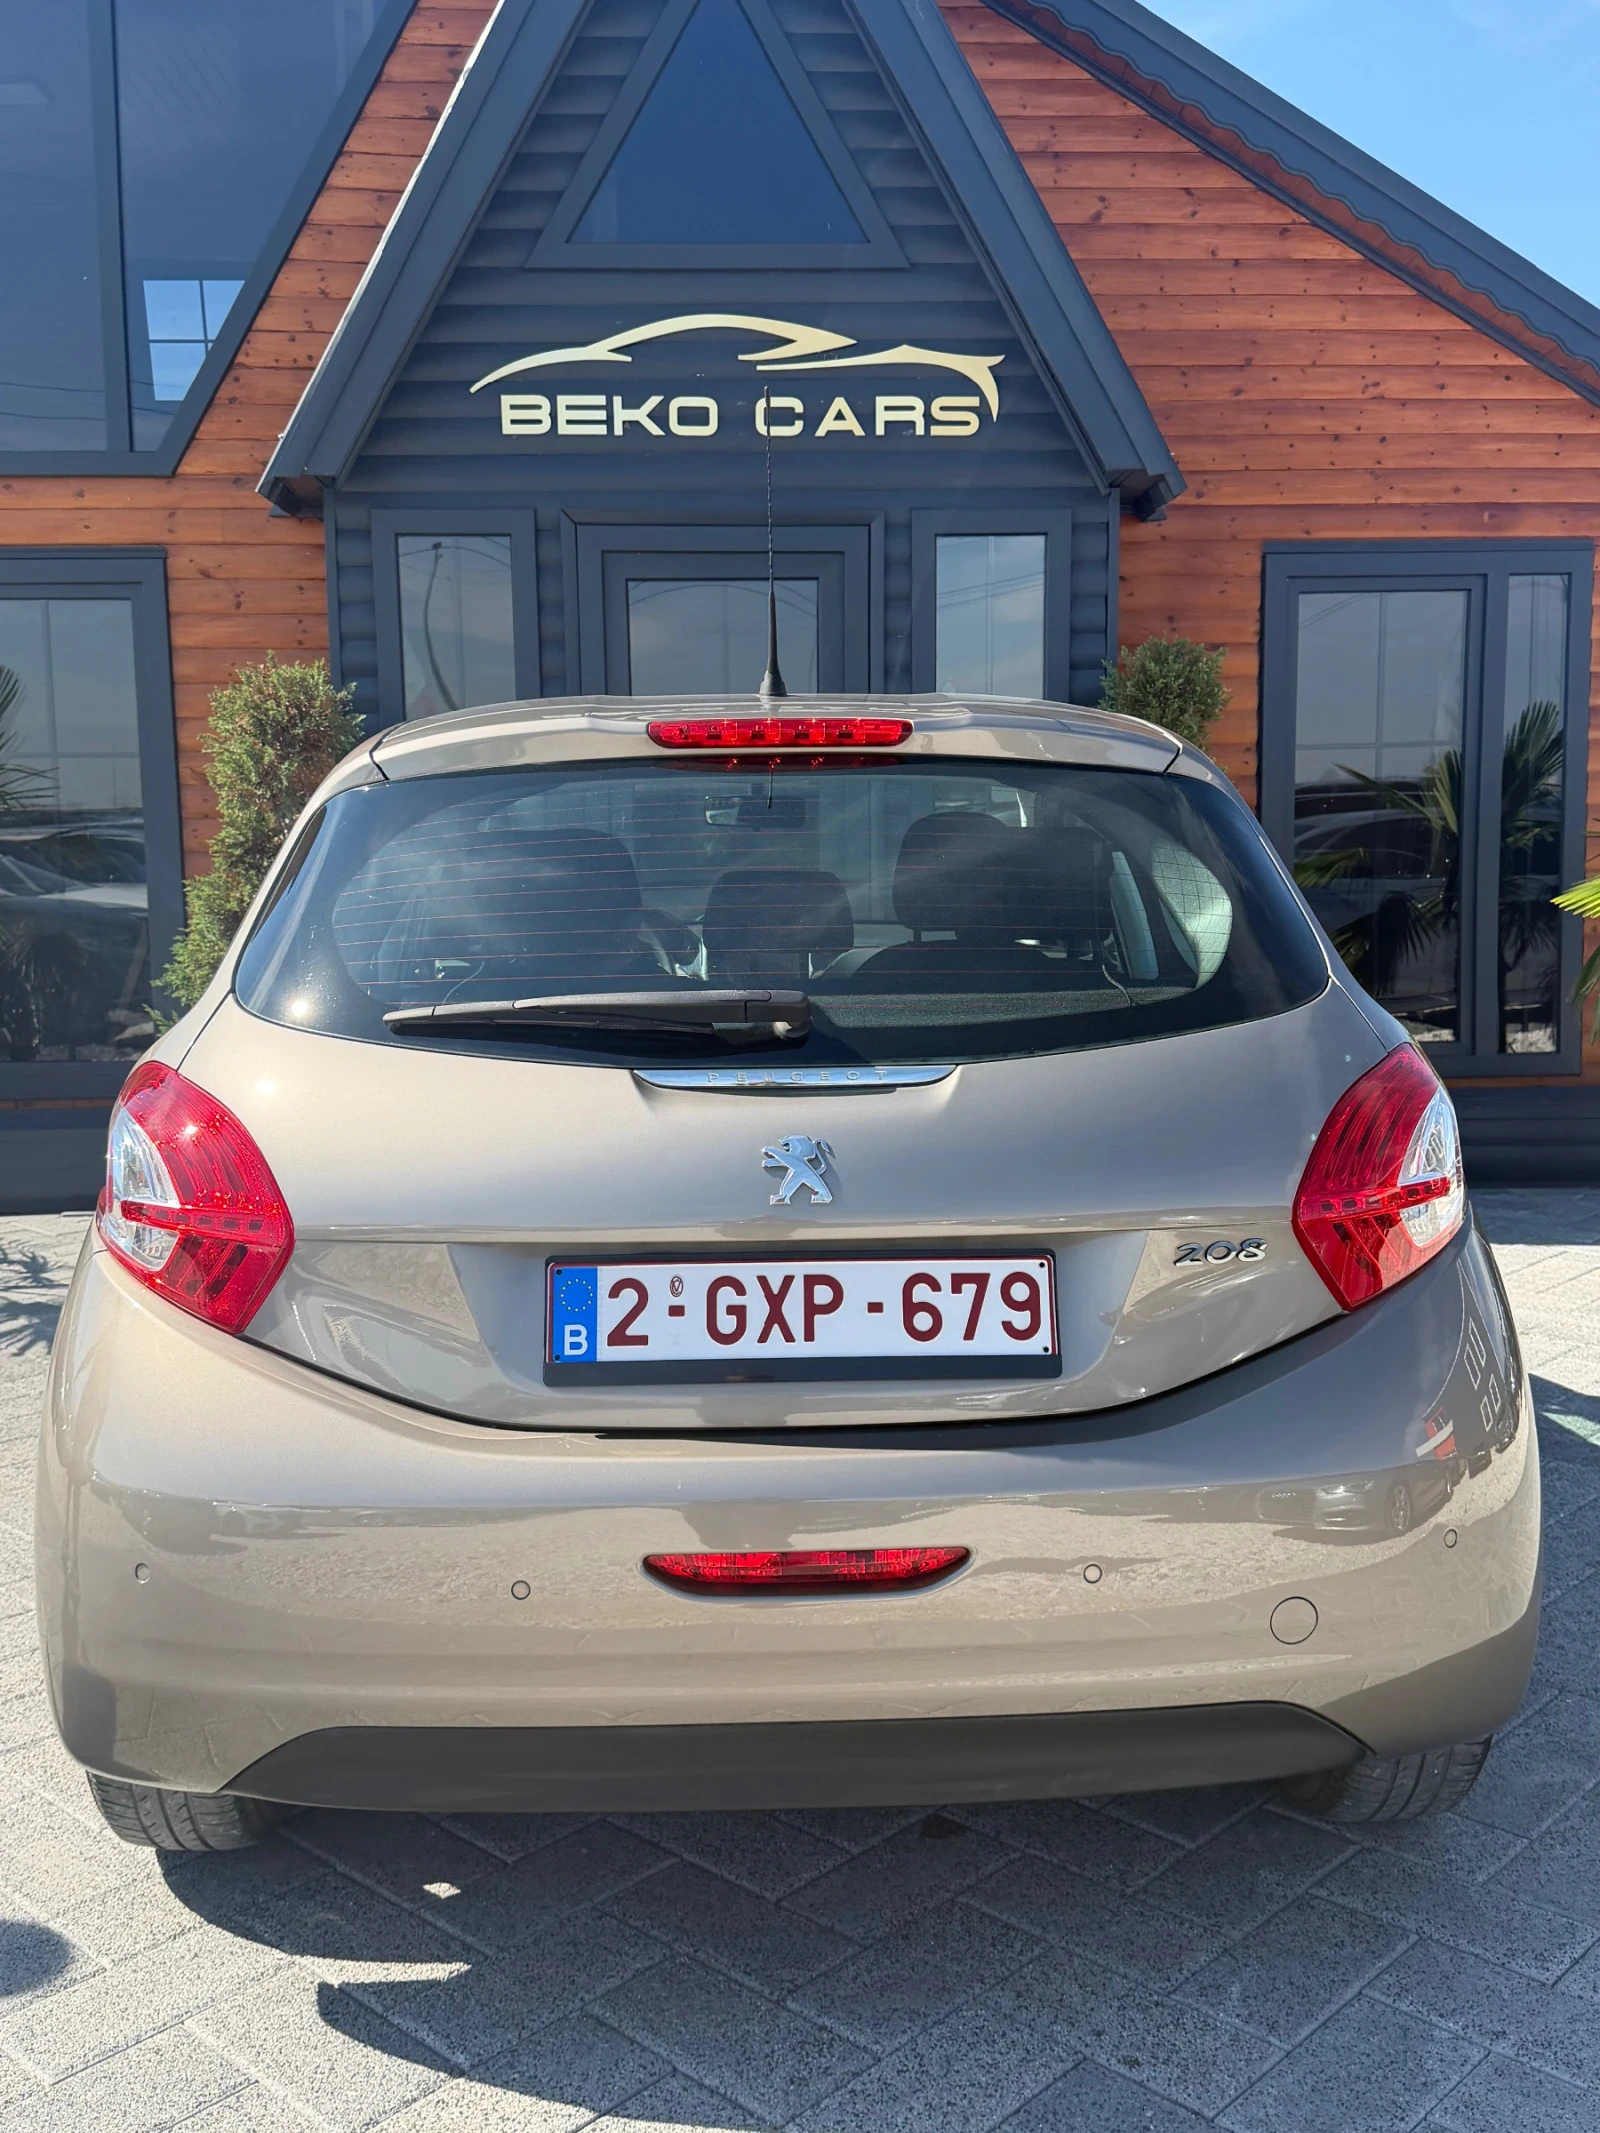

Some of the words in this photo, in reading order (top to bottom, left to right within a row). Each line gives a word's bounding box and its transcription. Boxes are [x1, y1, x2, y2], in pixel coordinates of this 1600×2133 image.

[501, 394, 718, 437] BEKO
[755, 394, 980, 437] CARS
[707, 1069, 888, 1084] PEUGEOT
[1173, 1237, 1268, 1267] 208
[563, 1324, 589, 1356] B
